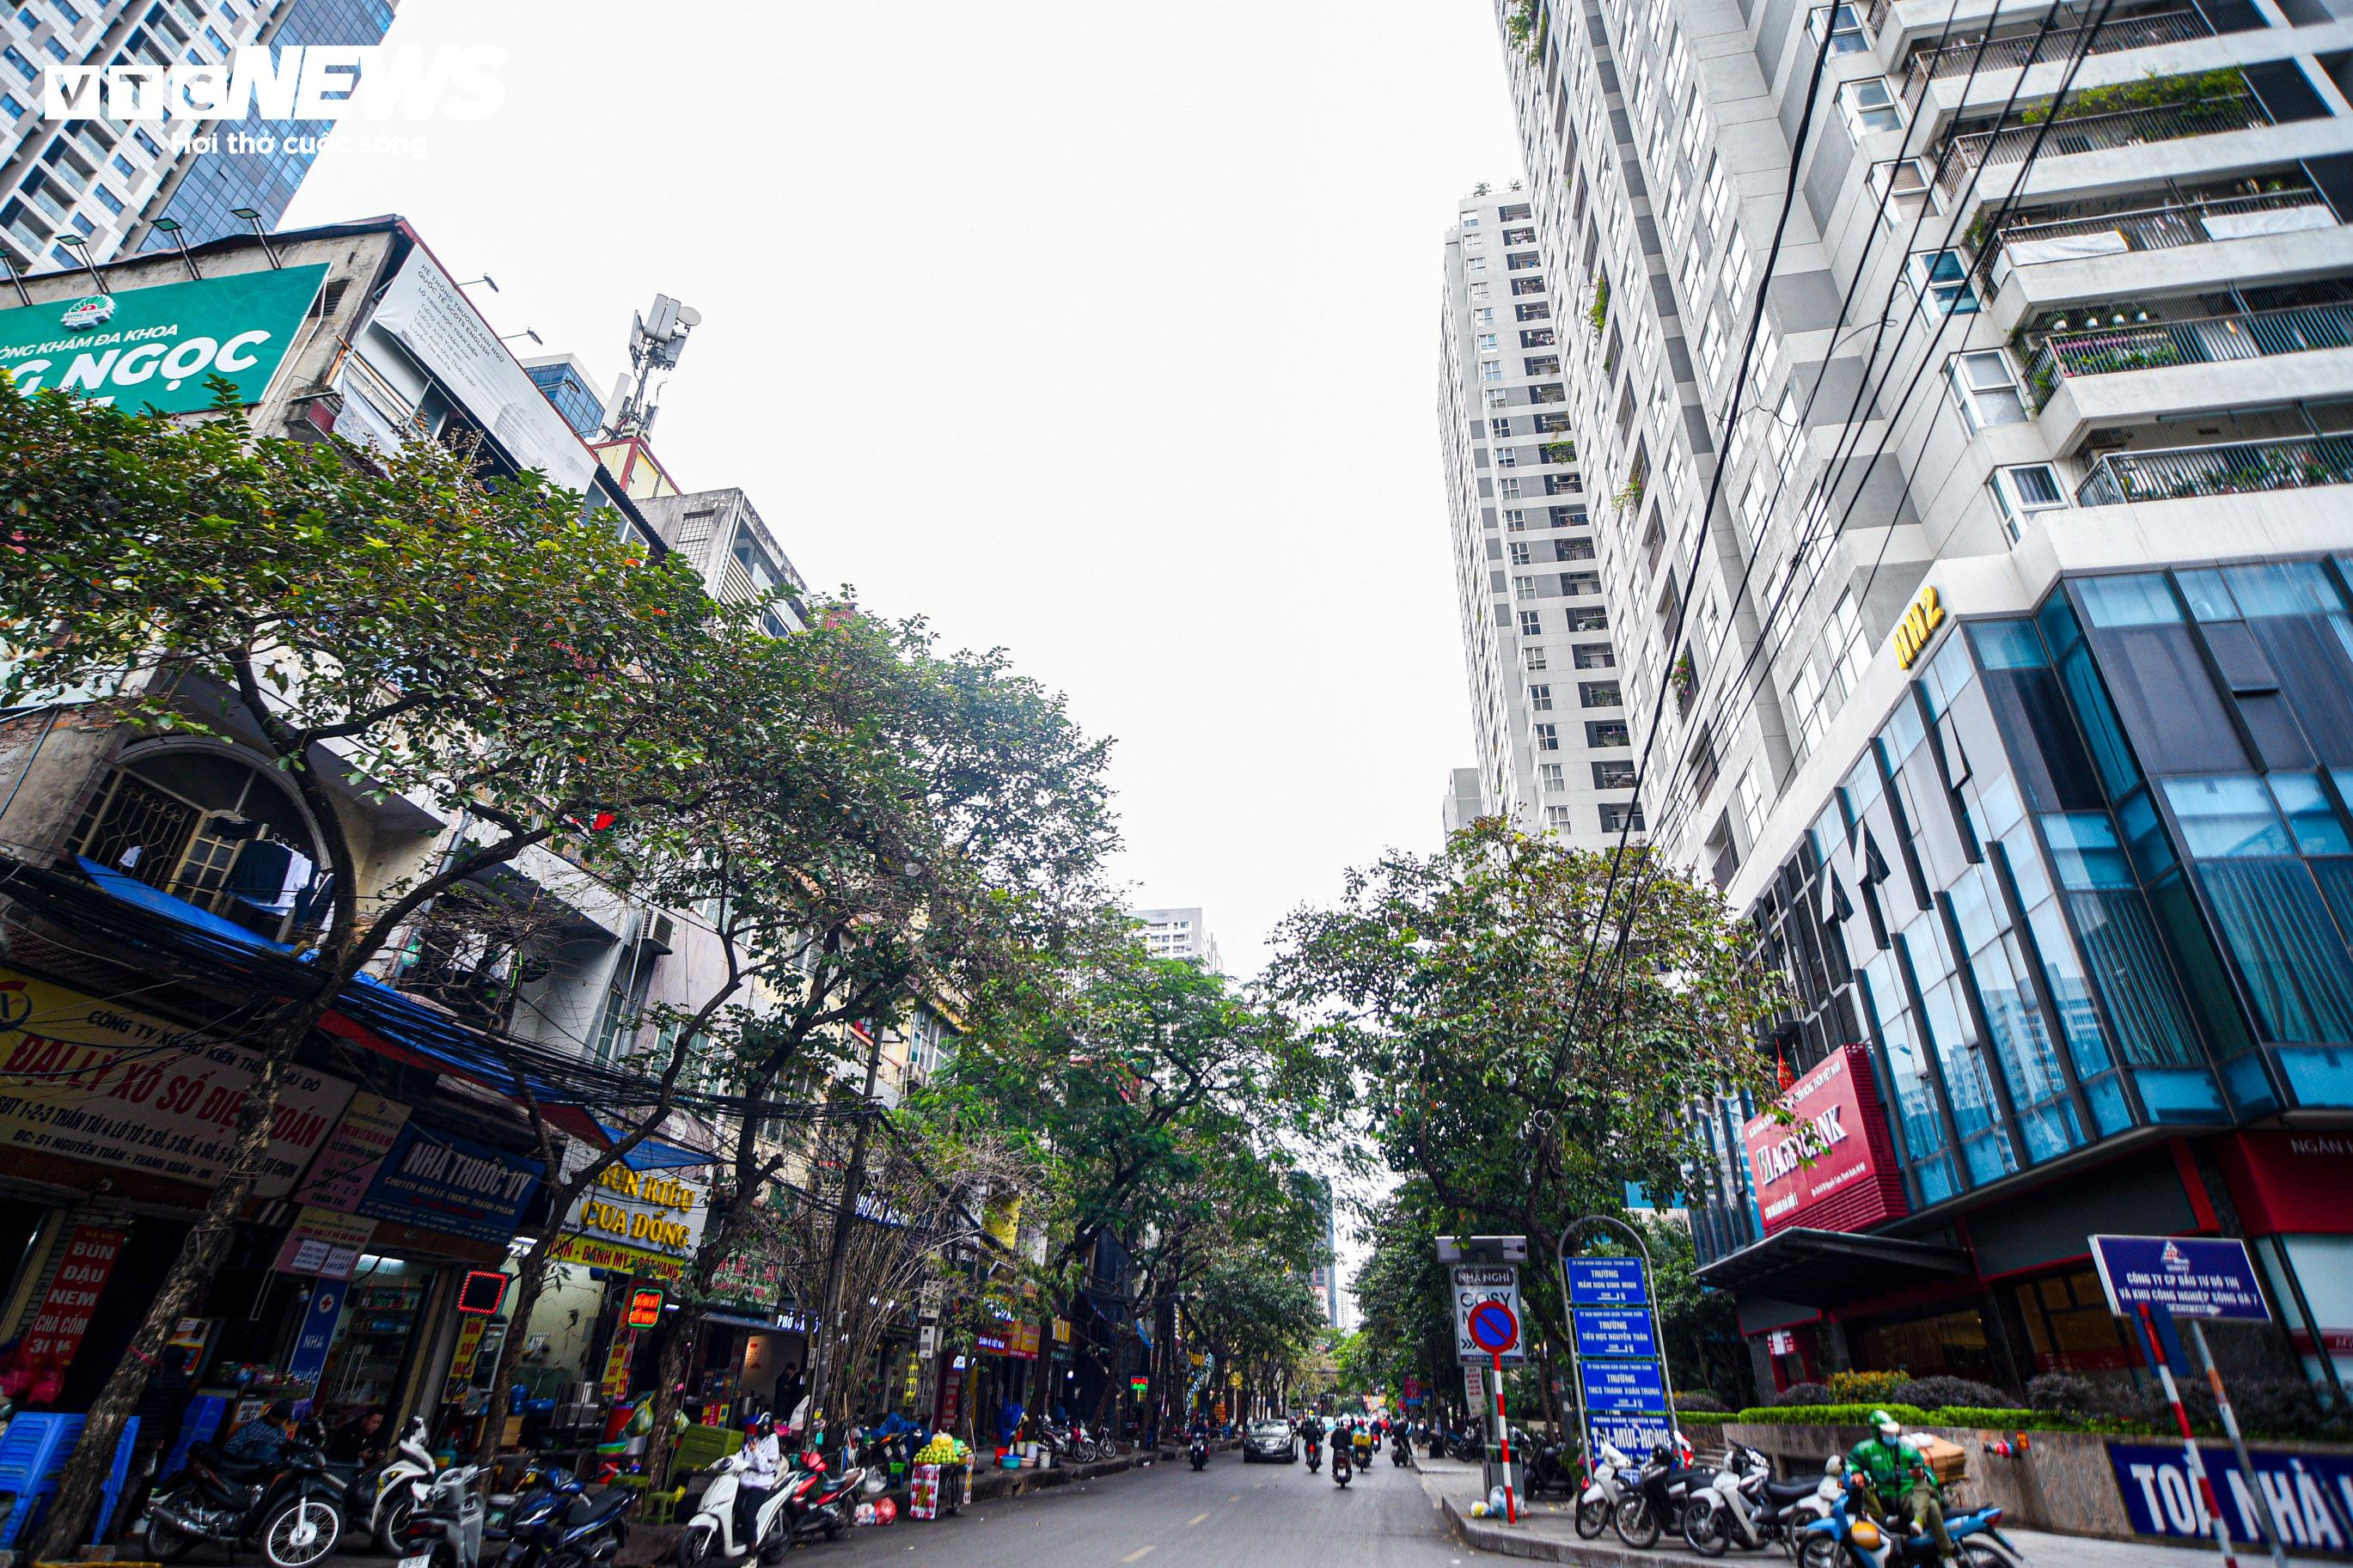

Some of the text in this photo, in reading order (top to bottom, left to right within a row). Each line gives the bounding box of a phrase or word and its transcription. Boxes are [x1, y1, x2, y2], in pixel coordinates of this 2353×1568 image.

[36, 335, 93, 355] KHÁM
[95, 333, 121, 346] ĐA
[123, 324, 178, 342] KHOA
[447, 304, 466, 327] SCOTS
[466, 327, 491, 357] ENGLISH
[479, 333, 492, 348] ANH
[58, 330, 272, 392] NGỌC
[1892, 586, 1945, 670] HH2
[135, 1023, 157, 1040] TY
[156, 1071, 217, 1114] SỐ
[35, 1133, 52, 1146] 51
[132, 1153, 168, 1170] THANH
[2289, 1134, 2344, 1155] NGÂN
[402, 1142, 454, 1182] NHÀ
[445, 1152, 509, 1197] THUỐC
[581, 1200, 627, 1235] CUA
[71, 1241, 116, 1260] BÚN
[62, 1264, 107, 1284] ĐẬU
[2126, 1271, 2151, 1285] CÔNG
[2151, 1273, 2162, 1285] TY
[2165, 1273, 2176, 1286] CP
[48, 1289, 99, 1307] NEM
[2131, 1288, 2150, 1301] KHU
[2151, 1287, 2177, 1303] CÔNG
